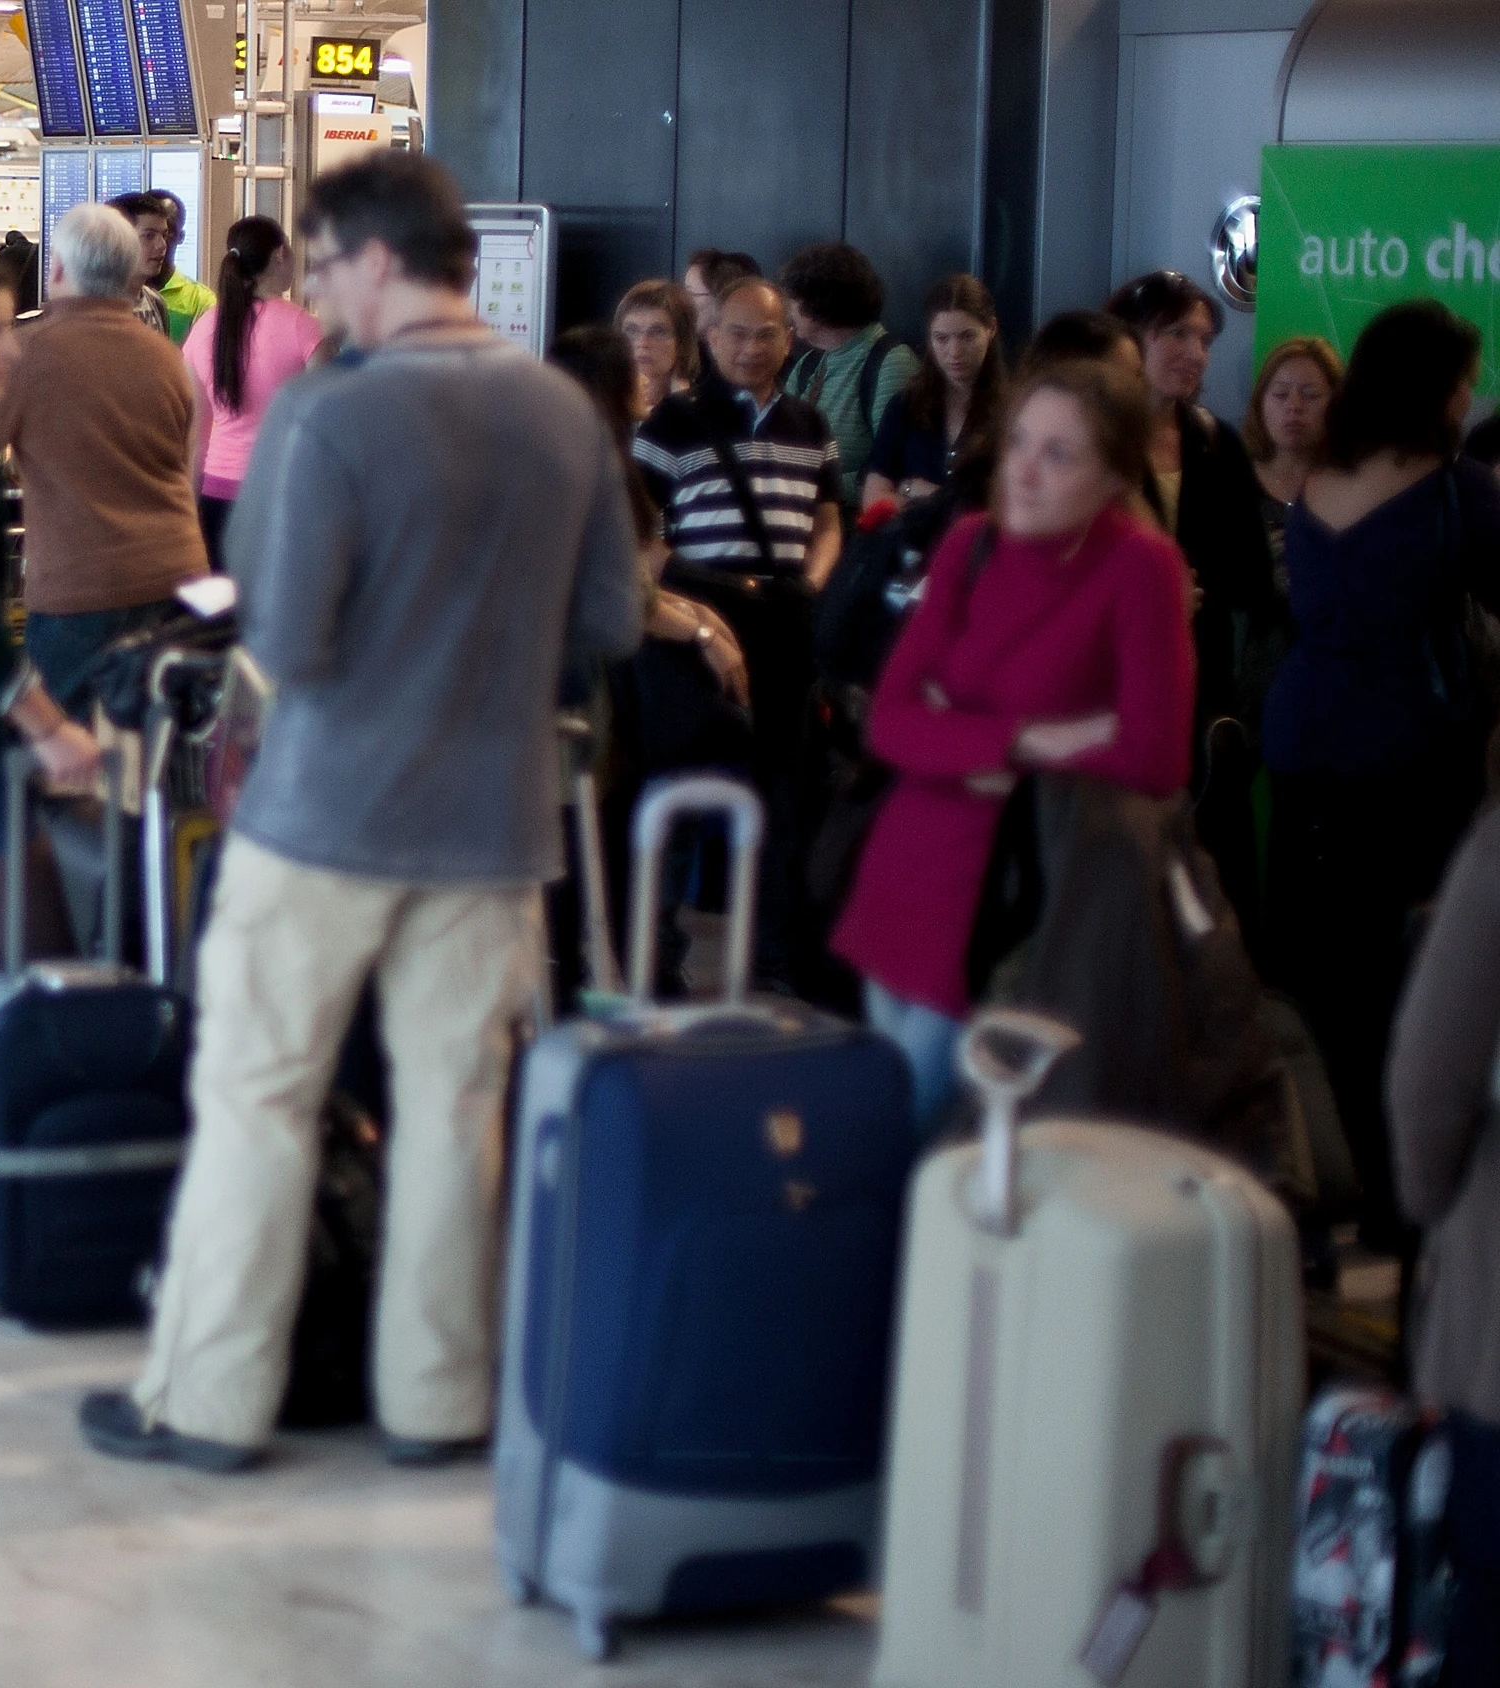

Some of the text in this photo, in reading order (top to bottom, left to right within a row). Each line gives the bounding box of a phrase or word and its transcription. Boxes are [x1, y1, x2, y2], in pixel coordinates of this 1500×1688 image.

[317, 44, 372, 75] 854
[324, 130, 367, 140] IBERIA
[1299, 228, 1410, 278] auto
